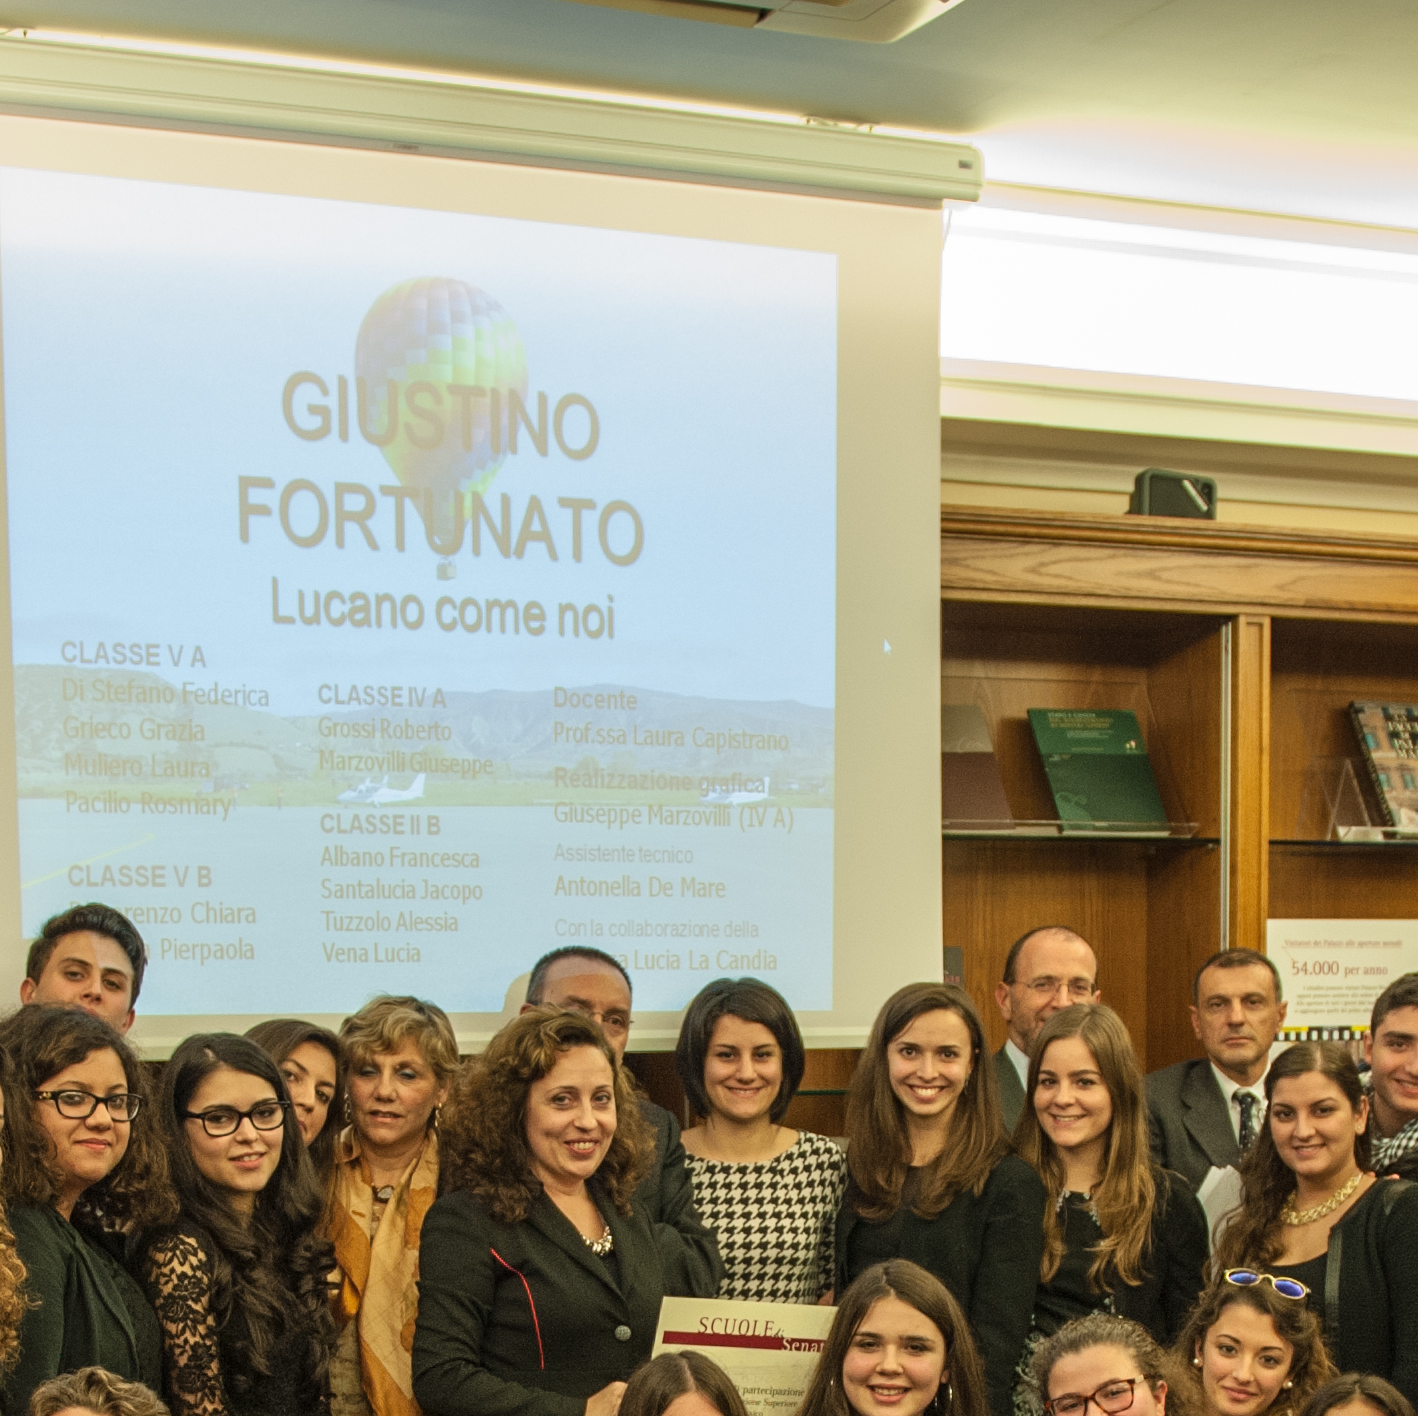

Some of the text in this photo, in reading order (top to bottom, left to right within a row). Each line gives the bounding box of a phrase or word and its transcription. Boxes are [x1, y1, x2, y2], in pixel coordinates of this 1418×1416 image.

[282, 371, 600, 460] GIUSTINO
[238, 475, 644, 567] FORTUNATO
[271, 576, 615, 639] Lucano come noi
[61, 641, 207, 668] CLASSE V A
[62, 679, 269, 708] Di Stefano Federica
[318, 684, 447, 709] CLASSE IV A
[553, 686, 637, 711] Docente
[64, 716, 205, 741] Grieco Grazia
[318, 717, 452, 741] Grossi Roberto
[553, 720, 790, 754] Prof.ssa Laura Capistrano
[65, 752, 211, 778] Muliero Laura
[319, 750, 494, 780] Marzovilli Giuseppe
[553, 766, 765, 798] Realizzazione grafica
[66, 791, 232, 821] Pacilio Rosmary
[553, 802, 794, 834] Giuseppe Marzovilli (IV A)
[320, 813, 441, 835] CLASSE II B
[320, 845, 480, 868] Albano Francesca
[554, 843, 694, 864] Assistente tecnico
[68, 864, 212, 887] CLASSE V B
[554, 874, 726, 899] Antonella De Mare
[320, 878, 483, 905] Santalucia Jacopo
[116, 901, 256, 924] renzo Chiara
[320, 910, 459, 932] Tuzzolo Alessia
[555, 918, 759, 939] Con la collaborazione della
[160, 937, 255, 965] Pierpaola
[322, 942, 421, 963] Vena Lucia
[634, 949, 681, 971] Lucia
[689, 949, 709, 971] La
[716, 949, 777, 971] Candia
[1292, 960, 1388, 978] 54.000 per anno
[698, 1316, 775, 1337] SCUOLE
[782, 1337, 825, 1353] Senat
[742, 1385, 805, 1398] partecipazione
